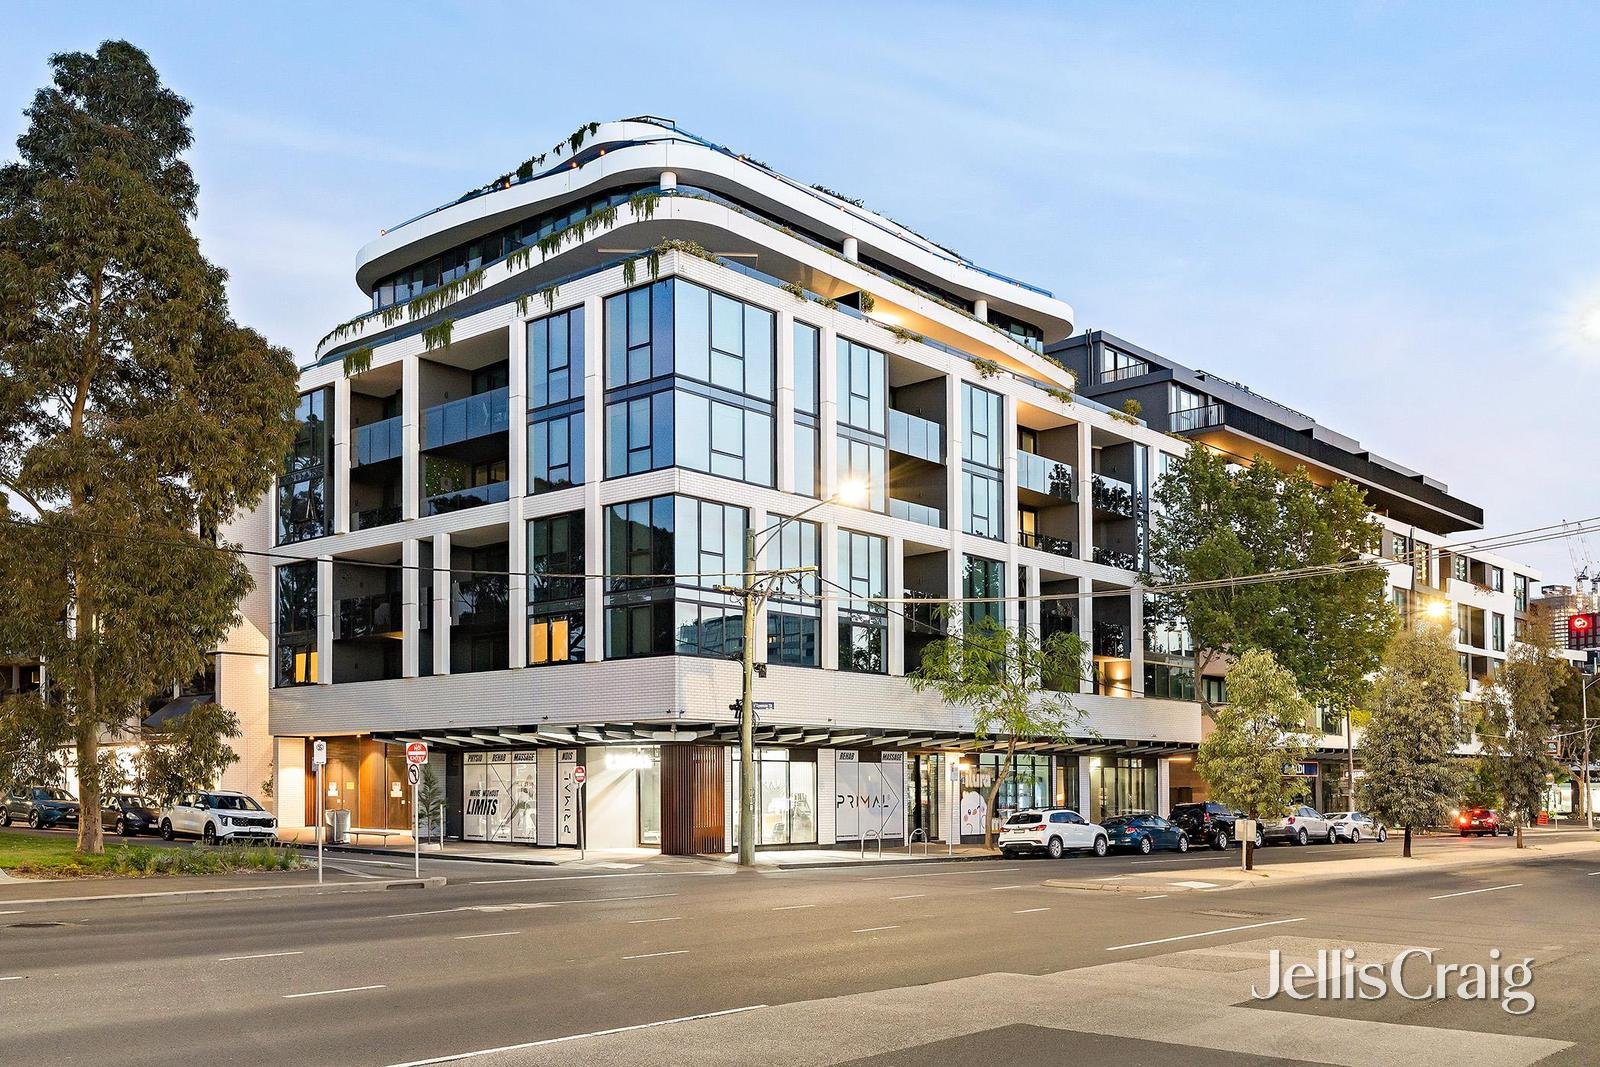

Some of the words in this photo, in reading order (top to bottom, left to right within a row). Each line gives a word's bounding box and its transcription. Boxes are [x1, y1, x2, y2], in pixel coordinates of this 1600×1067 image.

[467, 754, 483, 762] PHYSIO
[492, 753, 506, 762] REHAB
[513, 752, 535, 761] MASSAGE
[840, 752, 855, 760] REHAB
[882, 753, 902, 761] MASSAGE
[836, 794, 889, 809] PRIMAL
[466, 798, 498, 815] LIMITS
